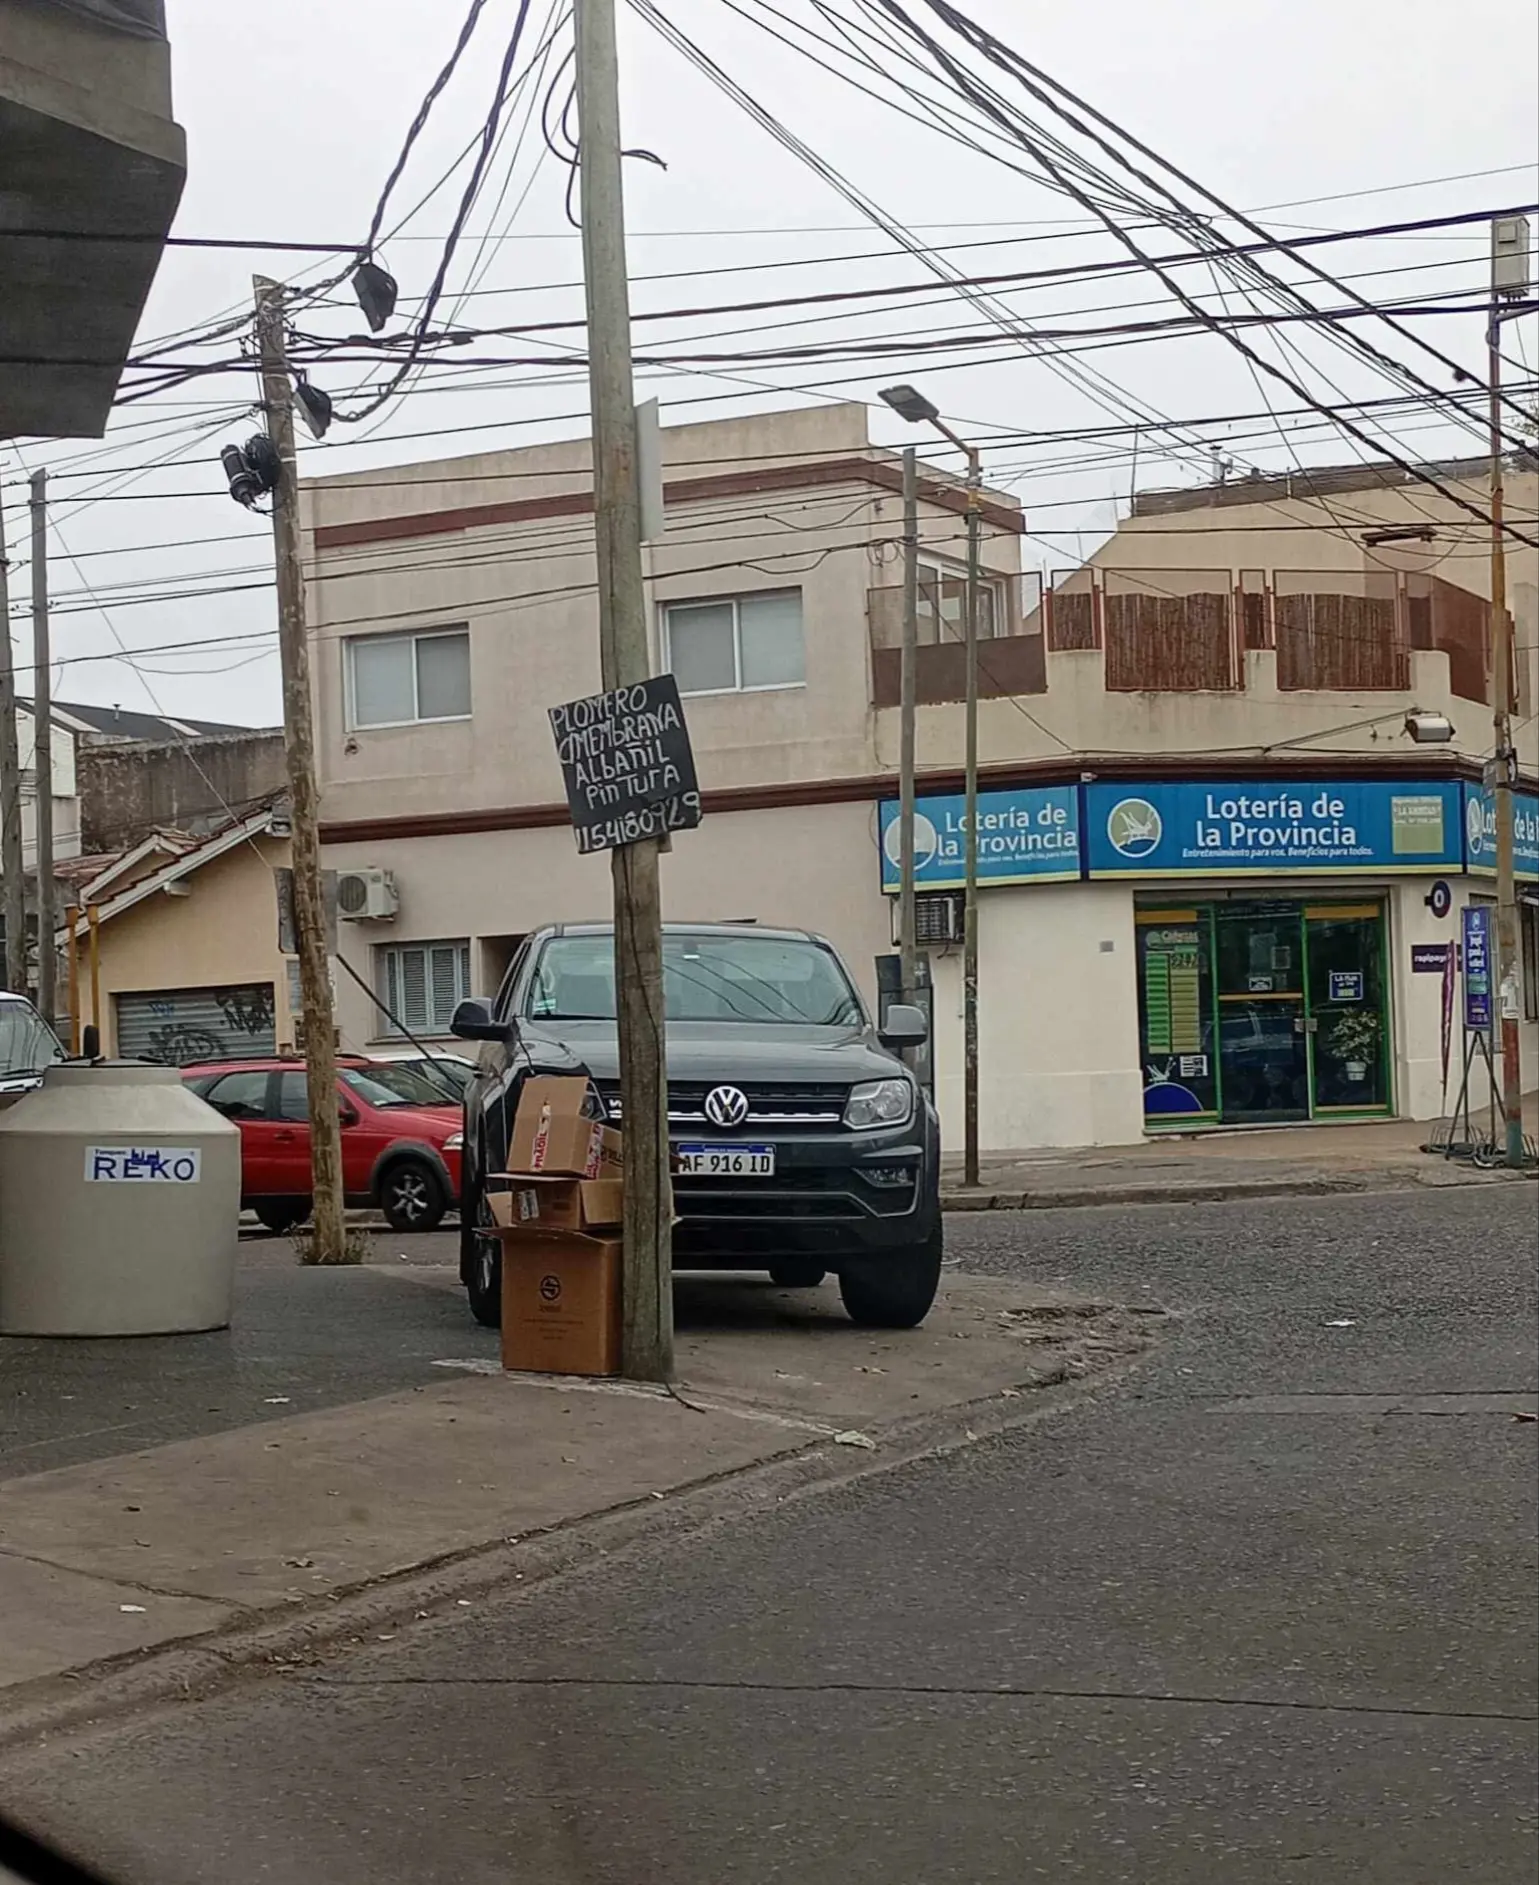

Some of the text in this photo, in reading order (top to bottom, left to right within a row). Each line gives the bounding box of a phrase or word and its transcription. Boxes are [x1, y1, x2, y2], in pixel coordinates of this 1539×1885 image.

[551, 685, 647, 737] PLOMERO
[1038, 803, 1066, 825] de
[1206, 792, 1344, 819] Lotería de
[938, 826, 1077, 856] la rovincia
[1196, 820, 1356, 846] la Provincia
[94, 1156, 195, 1181] REKO
[682, 1155, 771, 1172] AF 916 ID
